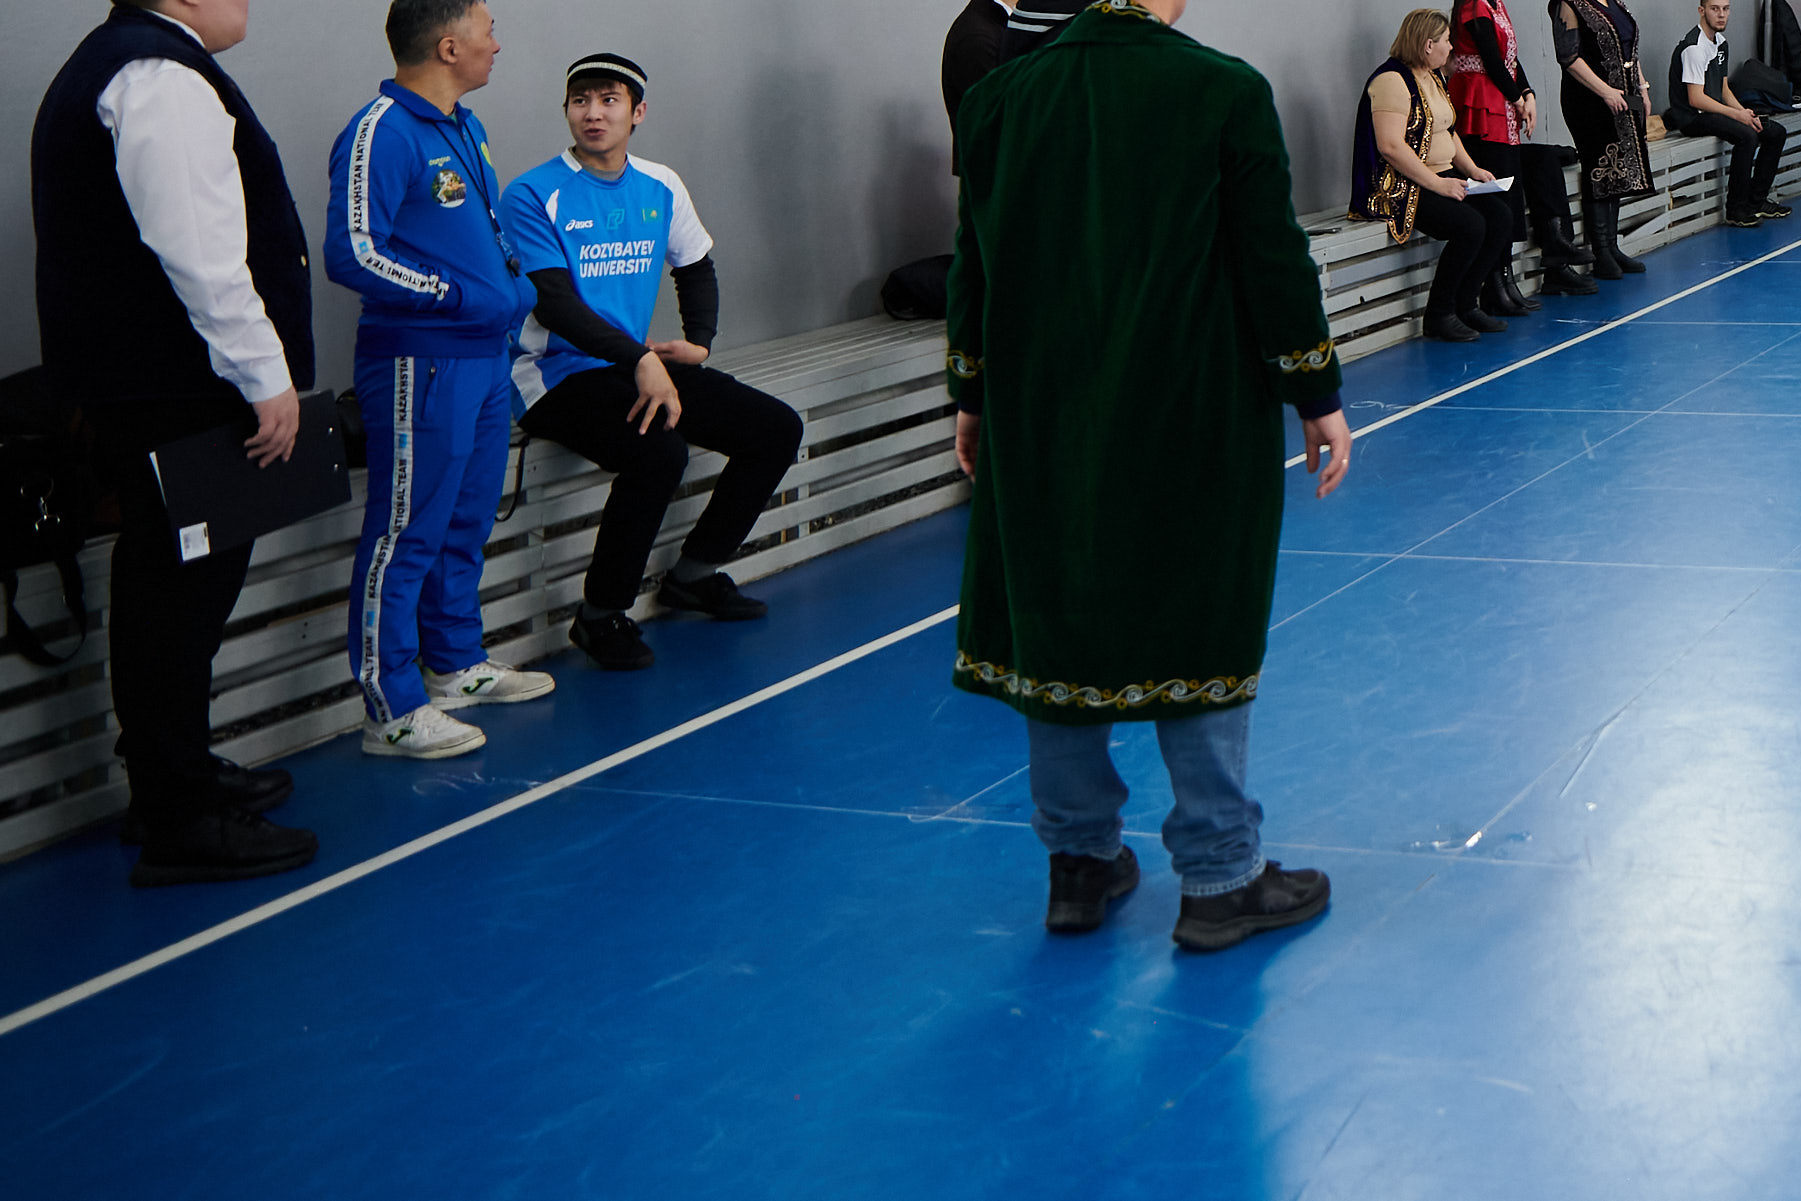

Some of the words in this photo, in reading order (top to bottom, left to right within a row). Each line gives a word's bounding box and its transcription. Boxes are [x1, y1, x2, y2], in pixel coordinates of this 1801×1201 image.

[355, 118, 372, 162] NATIONAL
[353, 165, 363, 232] KAZAKHSTAN
[571, 220, 594, 230] asics
[579, 240, 656, 261] KOZYBAYEV
[579, 258, 653, 278] UNIVERSITY
[397, 458, 408, 486] TEAM
[364, 636, 374, 664] TEAM
